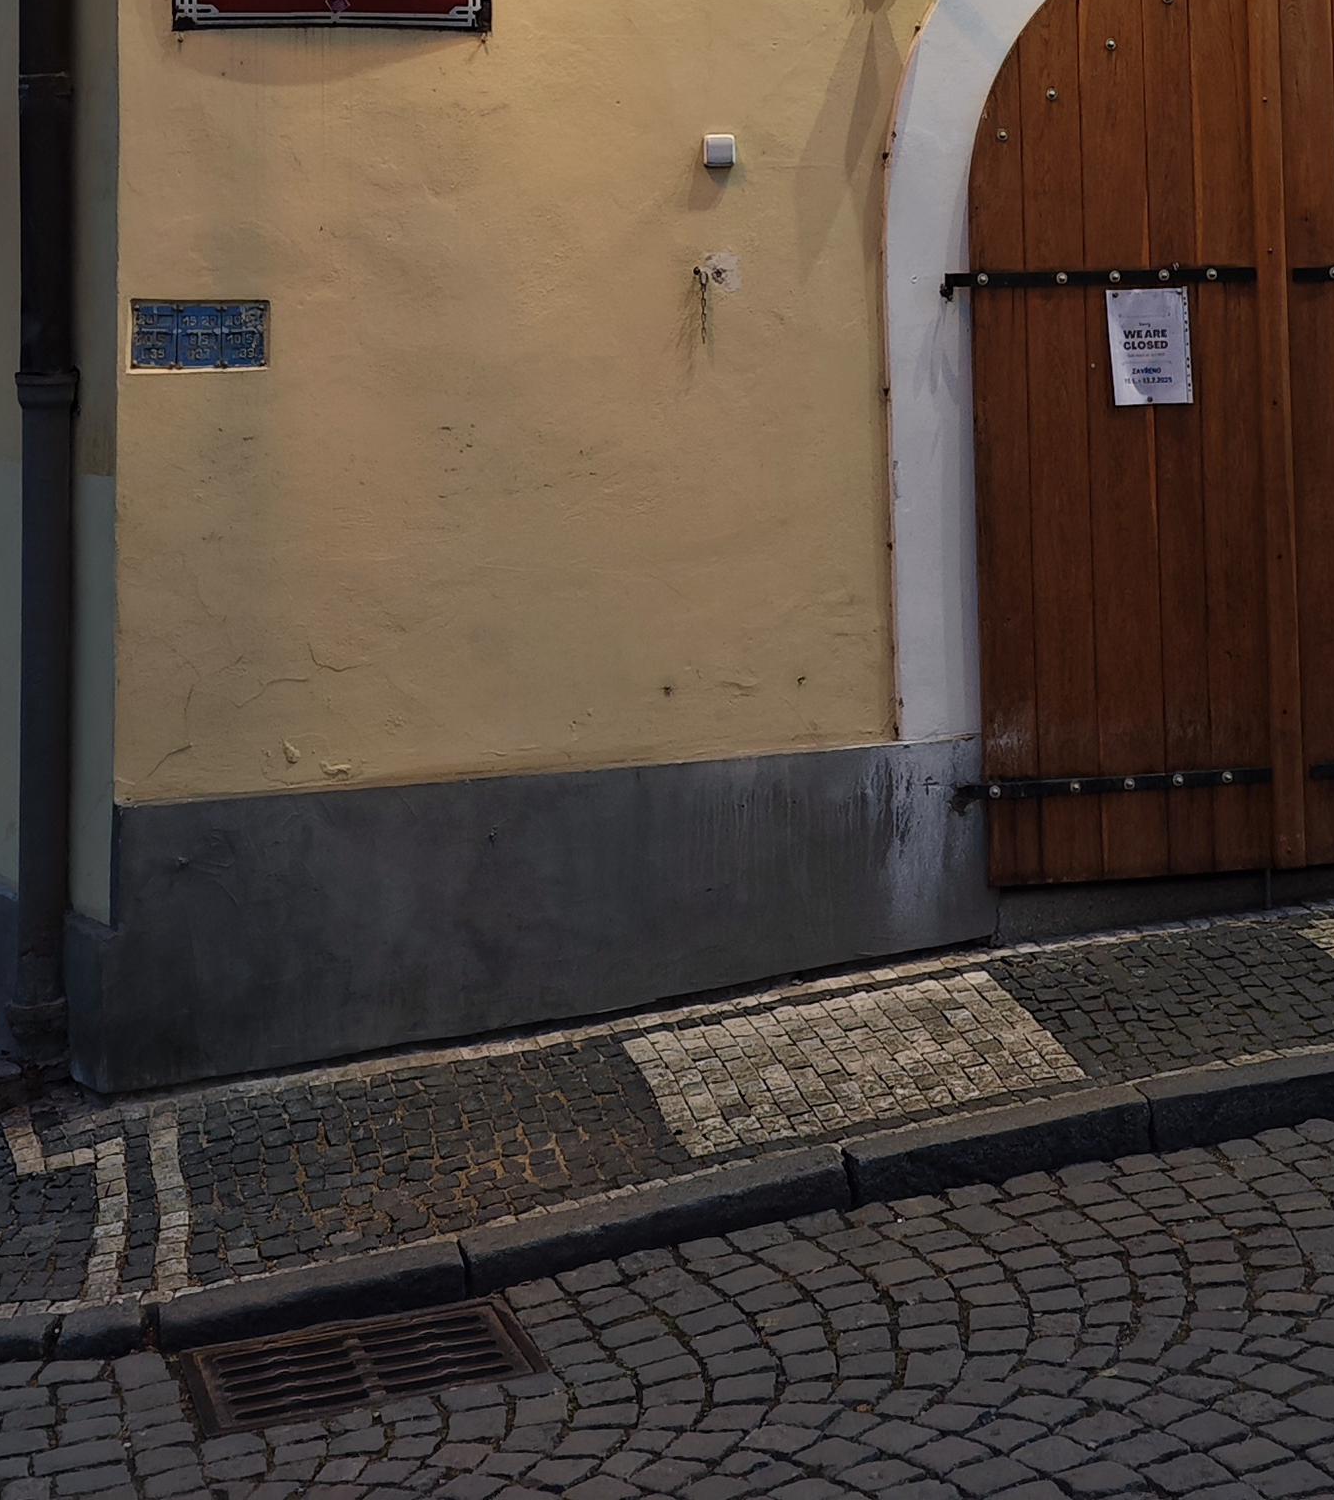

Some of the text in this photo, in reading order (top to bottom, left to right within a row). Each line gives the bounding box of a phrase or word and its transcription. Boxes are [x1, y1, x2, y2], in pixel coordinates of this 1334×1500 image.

[1123, 328, 1168, 339] WE ARE
[1123, 340, 1169, 350] CLOSED
